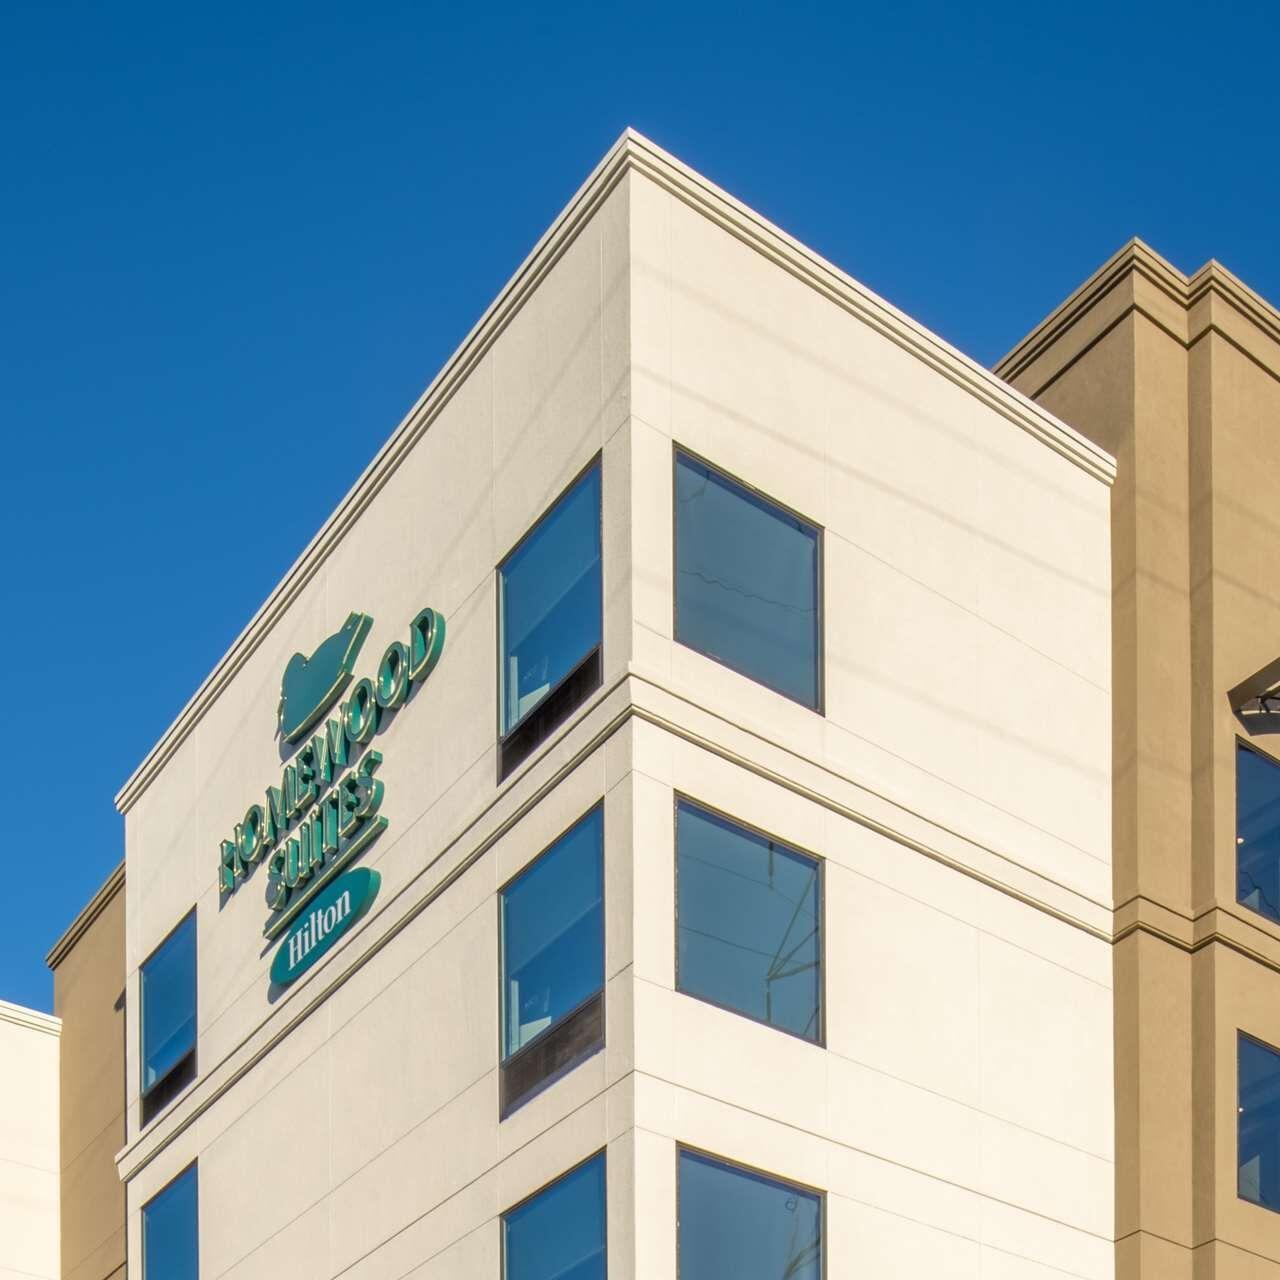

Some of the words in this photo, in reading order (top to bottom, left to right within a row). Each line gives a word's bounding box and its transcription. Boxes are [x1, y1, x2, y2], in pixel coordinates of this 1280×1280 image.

[220, 607, 446, 893] HOMEWOOD
[265, 749, 384, 911] SUITES
[287, 890, 352, 970] Hilton
